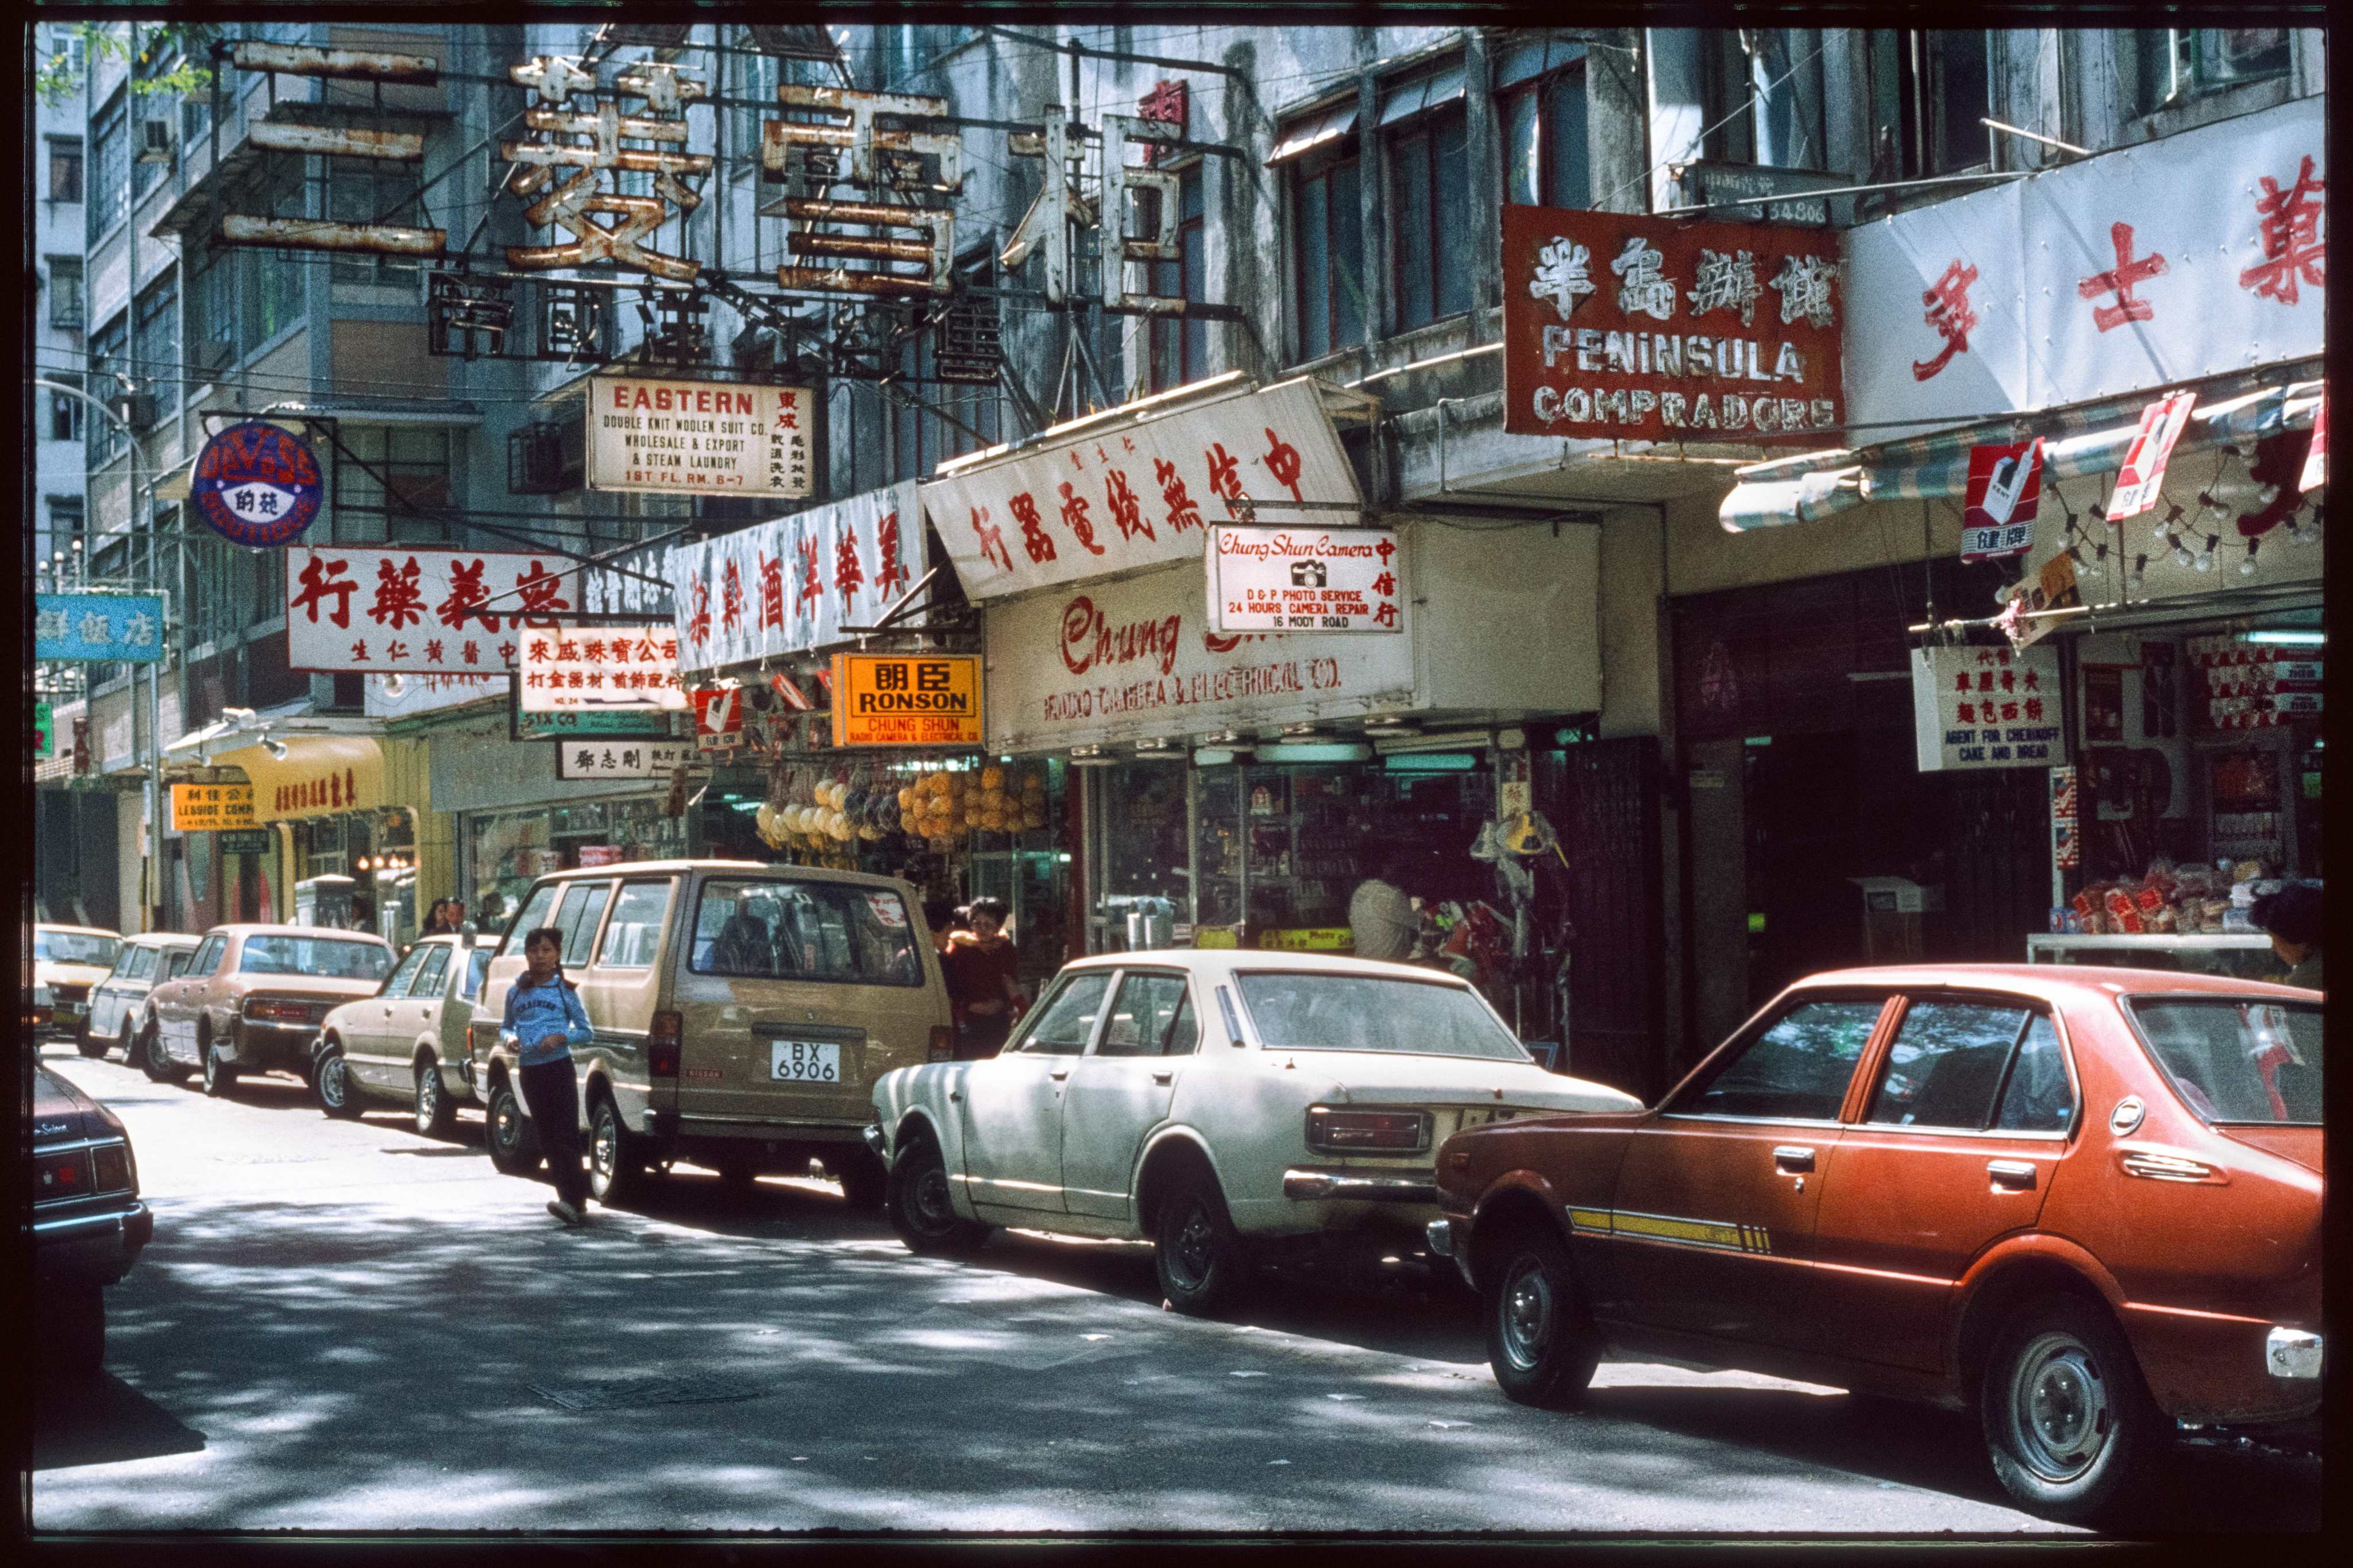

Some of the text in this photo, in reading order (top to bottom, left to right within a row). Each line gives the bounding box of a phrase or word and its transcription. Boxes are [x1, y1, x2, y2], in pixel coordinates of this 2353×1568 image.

[614, 386, 753, 415] EASTERN
[1533, 386, 1835, 431] COMPRADORS
[604, 415, 768, 435] DOUBLE KNIT WOOLEN SUIT CO.
[625, 435, 745, 452] WHOLESALE & EXPORT
[632, 453, 737, 470] & STEAM LAUNDRY
[626, 470, 651, 482] 1ST
[1992, 484, 2010, 500] KENT
[1976, 526, 2026, 550] 健牌
[1219, 533, 1373, 562] Chung Shun Camera
[1371, 538, 1399, 627] 中信行
[1247, 589, 1363, 602] D & P PHOTO SERVICE
[1229, 602, 1369, 615] 24 HOURS CAMERA REPAIR
[1274, 616, 1348, 628] 16 MODY ROAD
[1060, 595, 1182, 675] Chung
[875, 663, 951, 692] 朗臣
[859, 693, 966, 713] RONSON
[868, 718, 960, 731] CHUNG SHUN
[850, 732, 872, 742] RADIO
[877, 732, 908, 742] CAMERA
[912, 733, 917, 741] &
[921, 732, 963, 741] ELECTRICAL
[1945, 729, 1976, 744] AGENT
[1982, 729, 2000, 743] FOR
[1959, 744, 2048, 761] CAKE AND BREAD
[792, 1042, 820, 1062] BX
[778, 1060, 835, 1080] 6906
